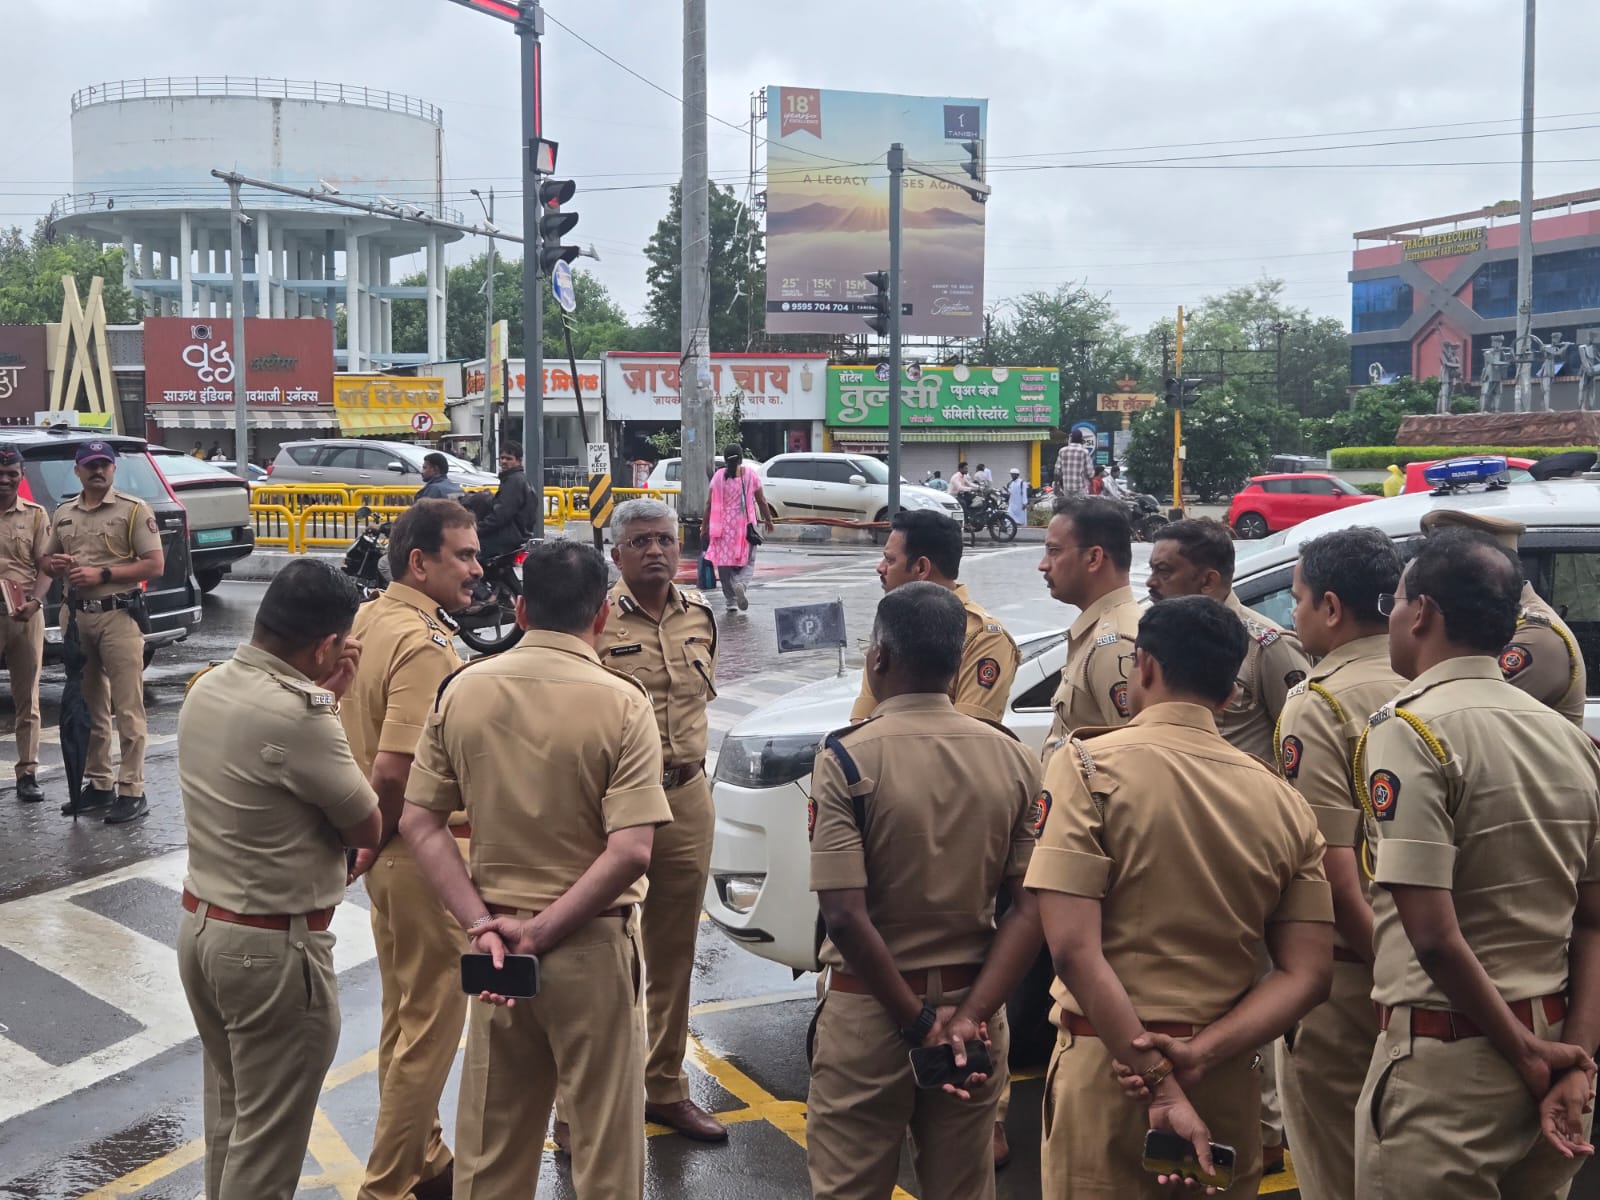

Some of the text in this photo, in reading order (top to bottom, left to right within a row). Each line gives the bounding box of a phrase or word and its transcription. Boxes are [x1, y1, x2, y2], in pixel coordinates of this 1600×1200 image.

[803, 174, 812, 183] A
[818, 175, 868, 186] LEGACY
[903, 178, 924, 189] SES
[1402, 227, 1483, 250] PRAGATI EXECUTIVE
[791, 302, 813, 310] 9595
[814, 303, 831, 311] 704
[832, 303, 849, 312] 704
[729, 364, 790, 394] चाय
[838, 370, 863, 383] हॉटेल
[199, 386, 233, 405] इंडियन
[245, 386, 280, 402] ावभाजी
[286, 386, 319, 402] स्नॅक्स
[977, 381, 999, 397] व्हेज
[417, 415, 428, 430] P
[805, 620, 814, 634] P
